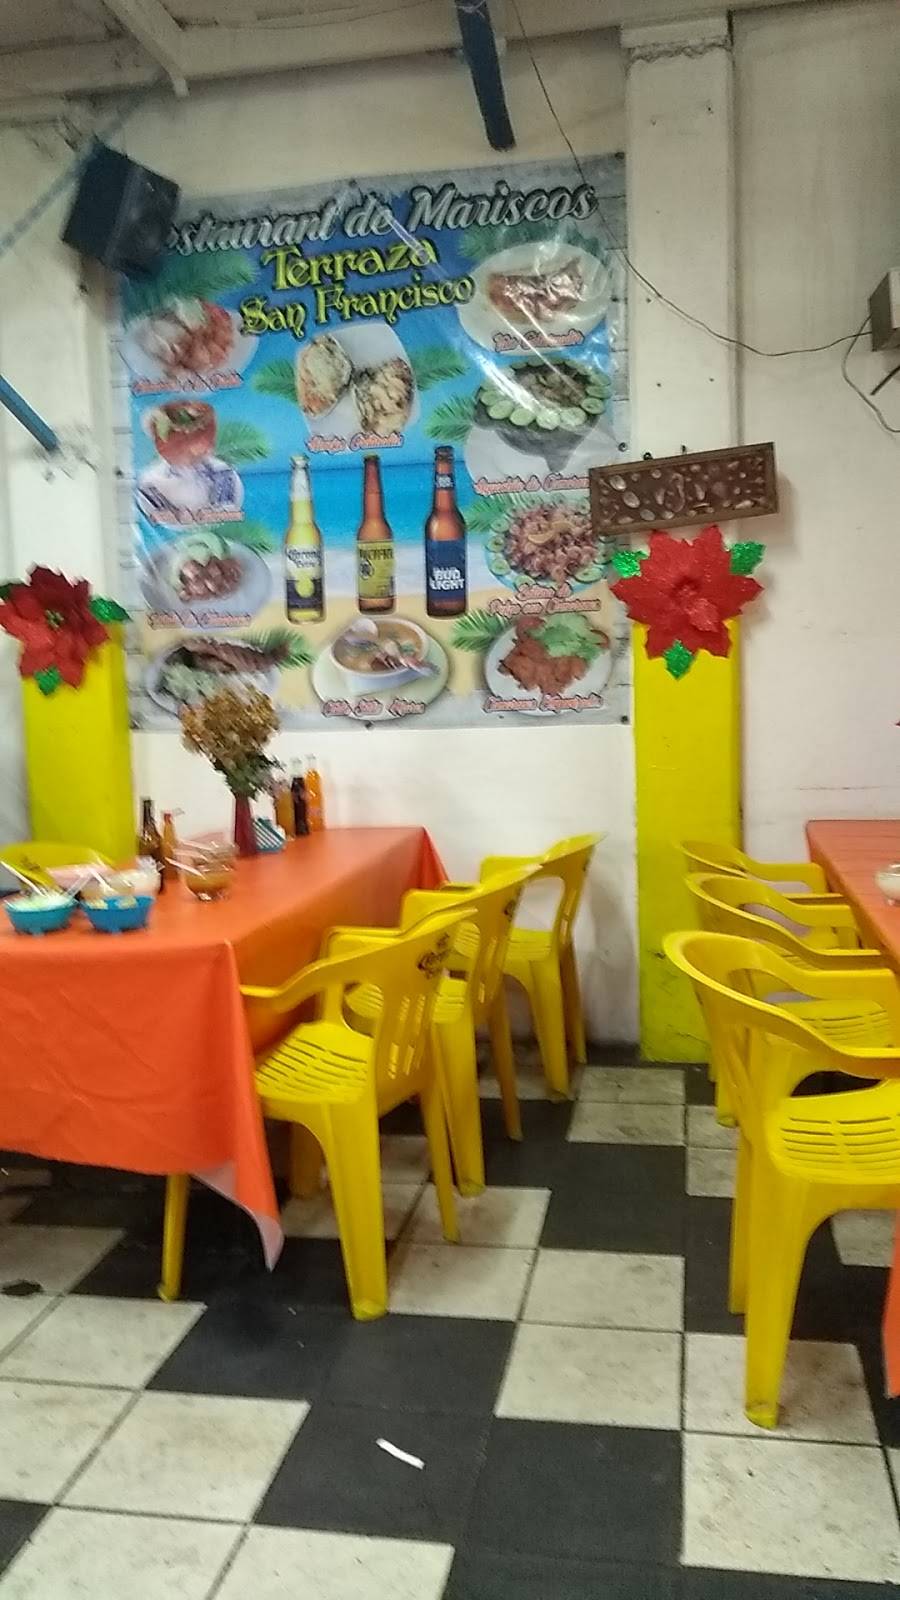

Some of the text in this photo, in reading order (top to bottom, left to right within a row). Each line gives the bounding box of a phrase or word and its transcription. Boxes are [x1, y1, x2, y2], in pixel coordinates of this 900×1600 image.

[167, 180, 598, 256] staurant de Mariscos
[260, 238, 440, 291] Terraza
[240, 271, 475, 342] San Francisco
[429, 578, 465, 591] LIGHT
[433, 566, 461, 580] BUD
